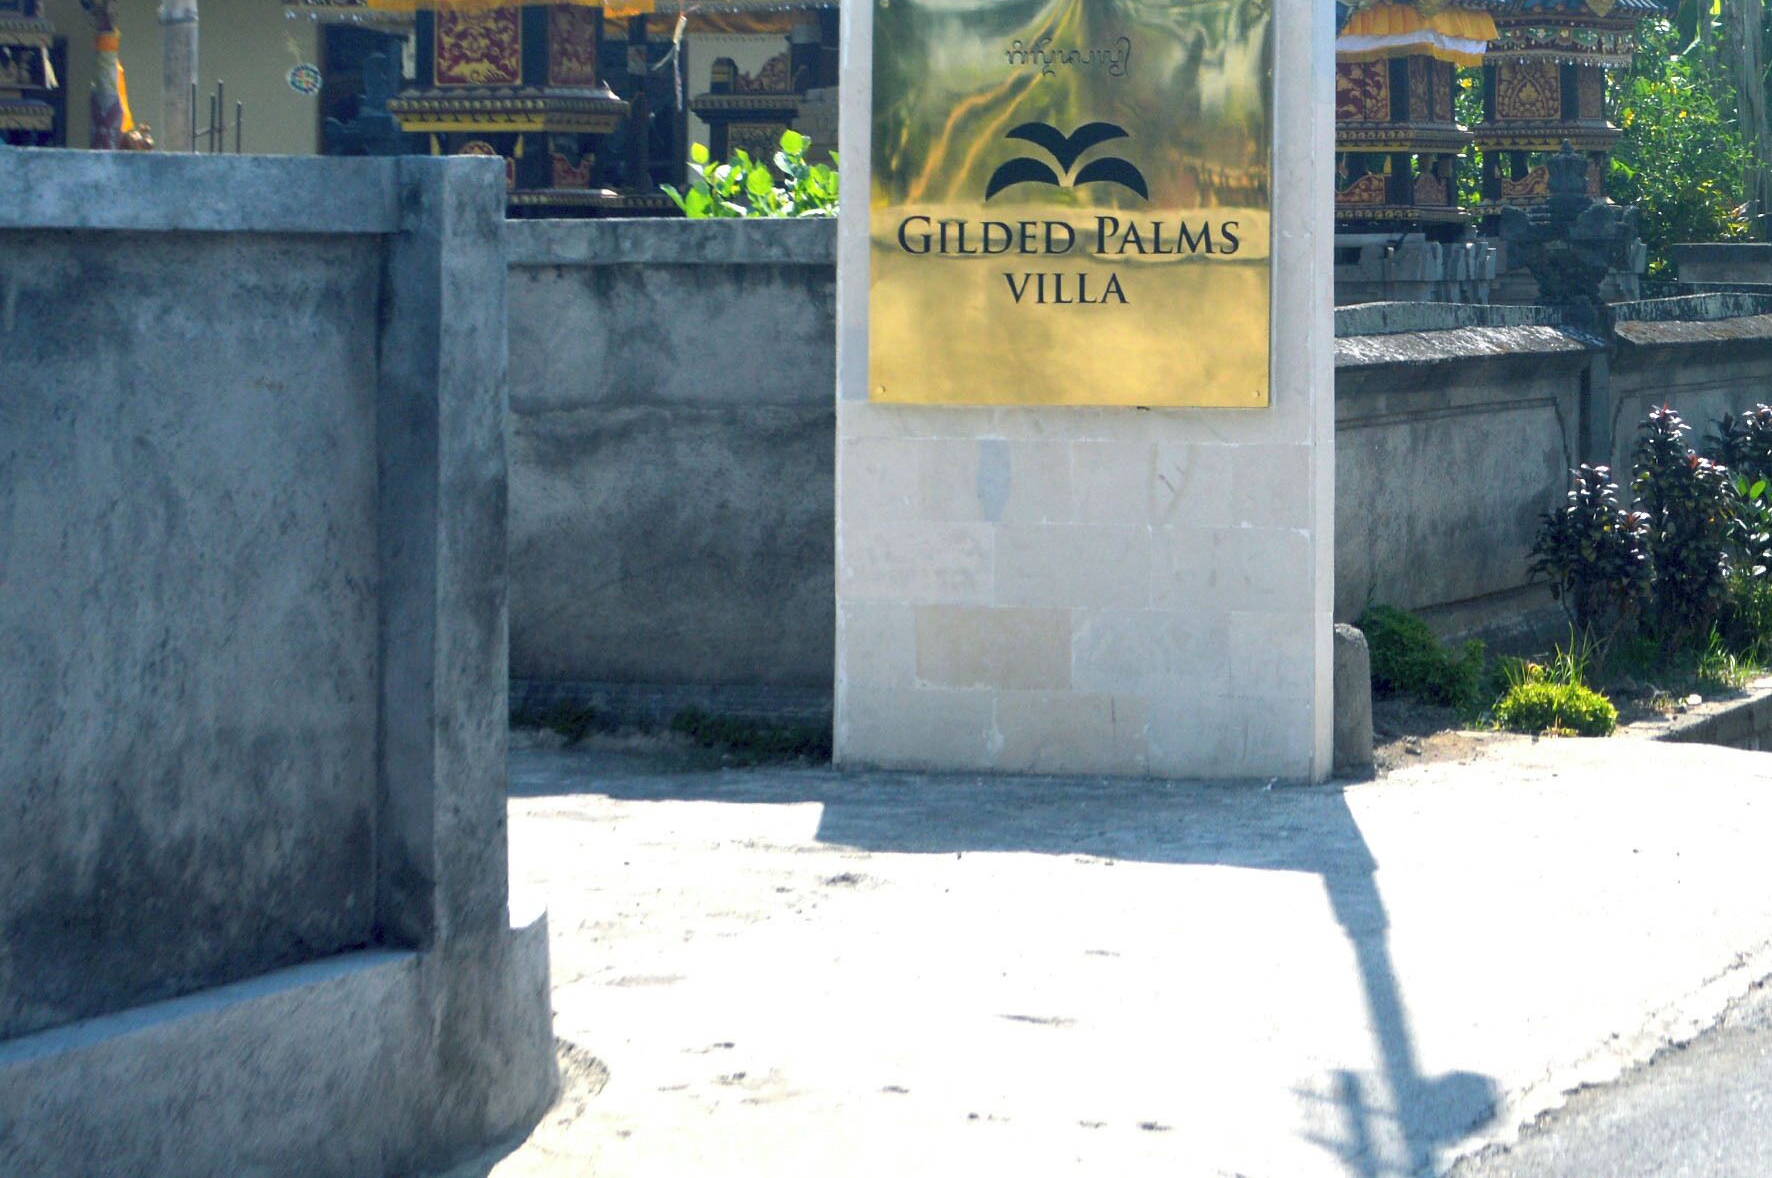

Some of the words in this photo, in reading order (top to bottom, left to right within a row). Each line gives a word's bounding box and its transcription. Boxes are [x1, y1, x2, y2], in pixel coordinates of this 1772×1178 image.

[898, 216, 1077, 255] GILDED
[1095, 216, 1241, 255] PALMS
[1003, 272, 1130, 305] VILLA
